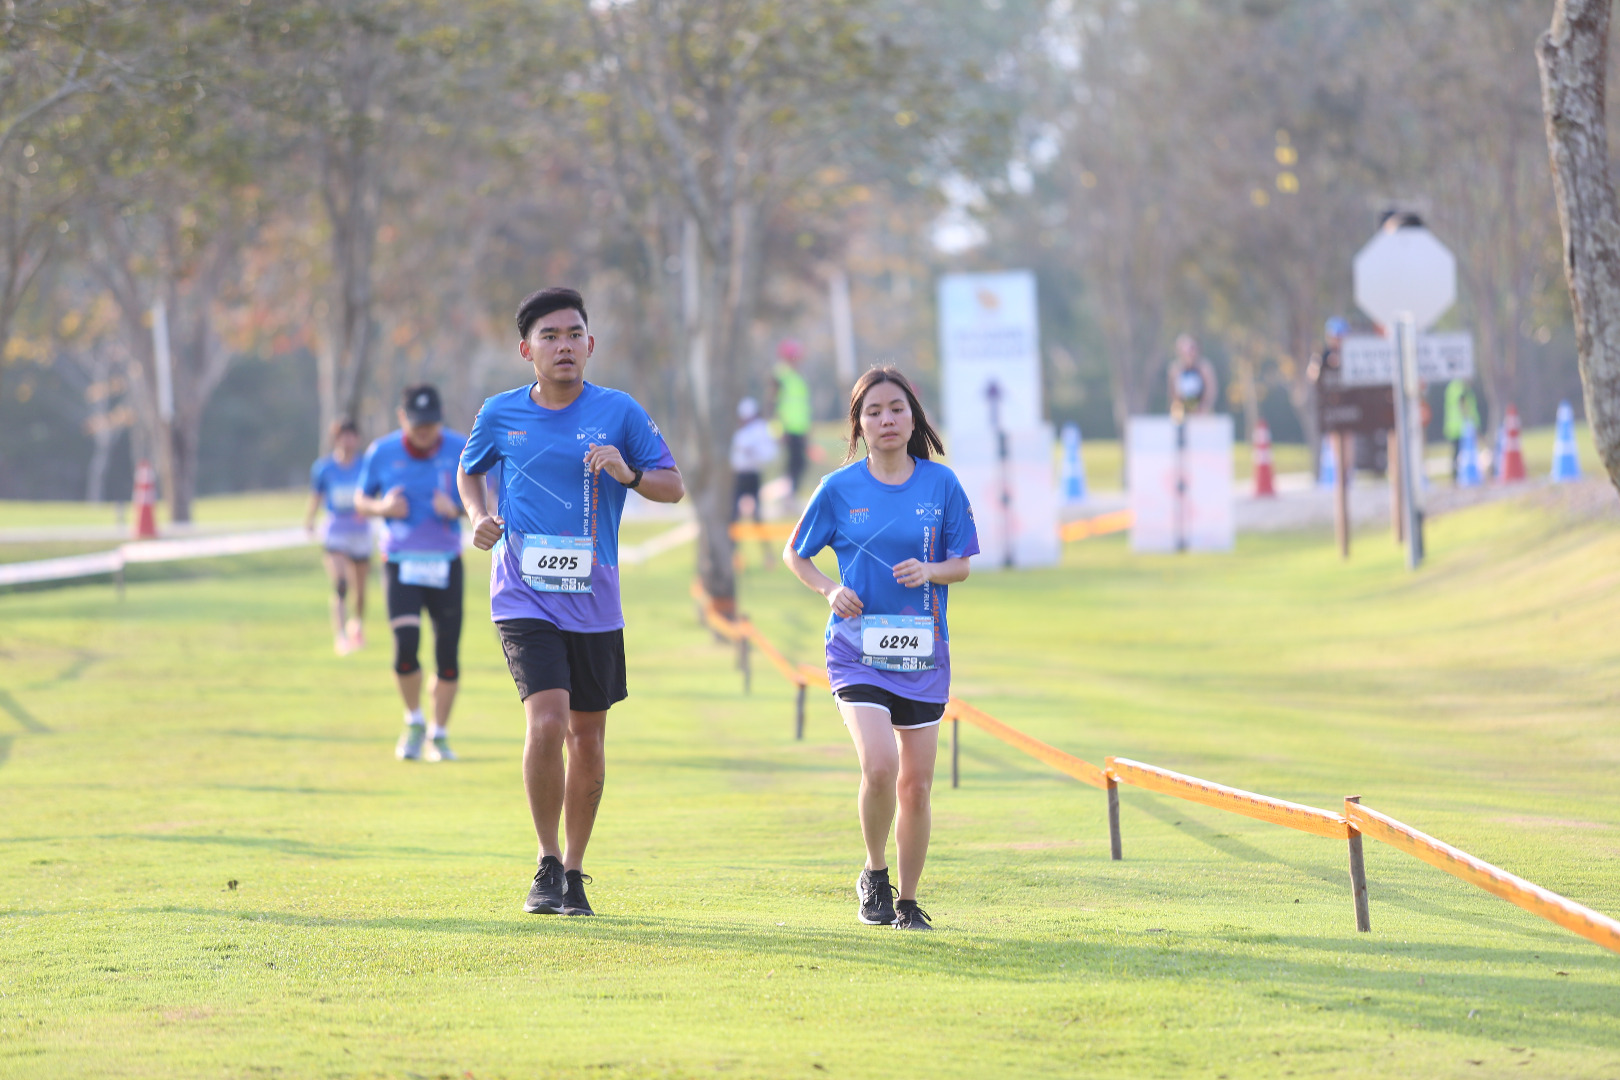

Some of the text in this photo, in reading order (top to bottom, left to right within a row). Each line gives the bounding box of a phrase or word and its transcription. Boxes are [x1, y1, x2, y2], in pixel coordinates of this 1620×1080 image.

[538, 555, 578, 570] 6295
[578, 582, 585, 590] 16
[880, 635, 918, 650] 6294
[918, 661, 926, 670] 16
